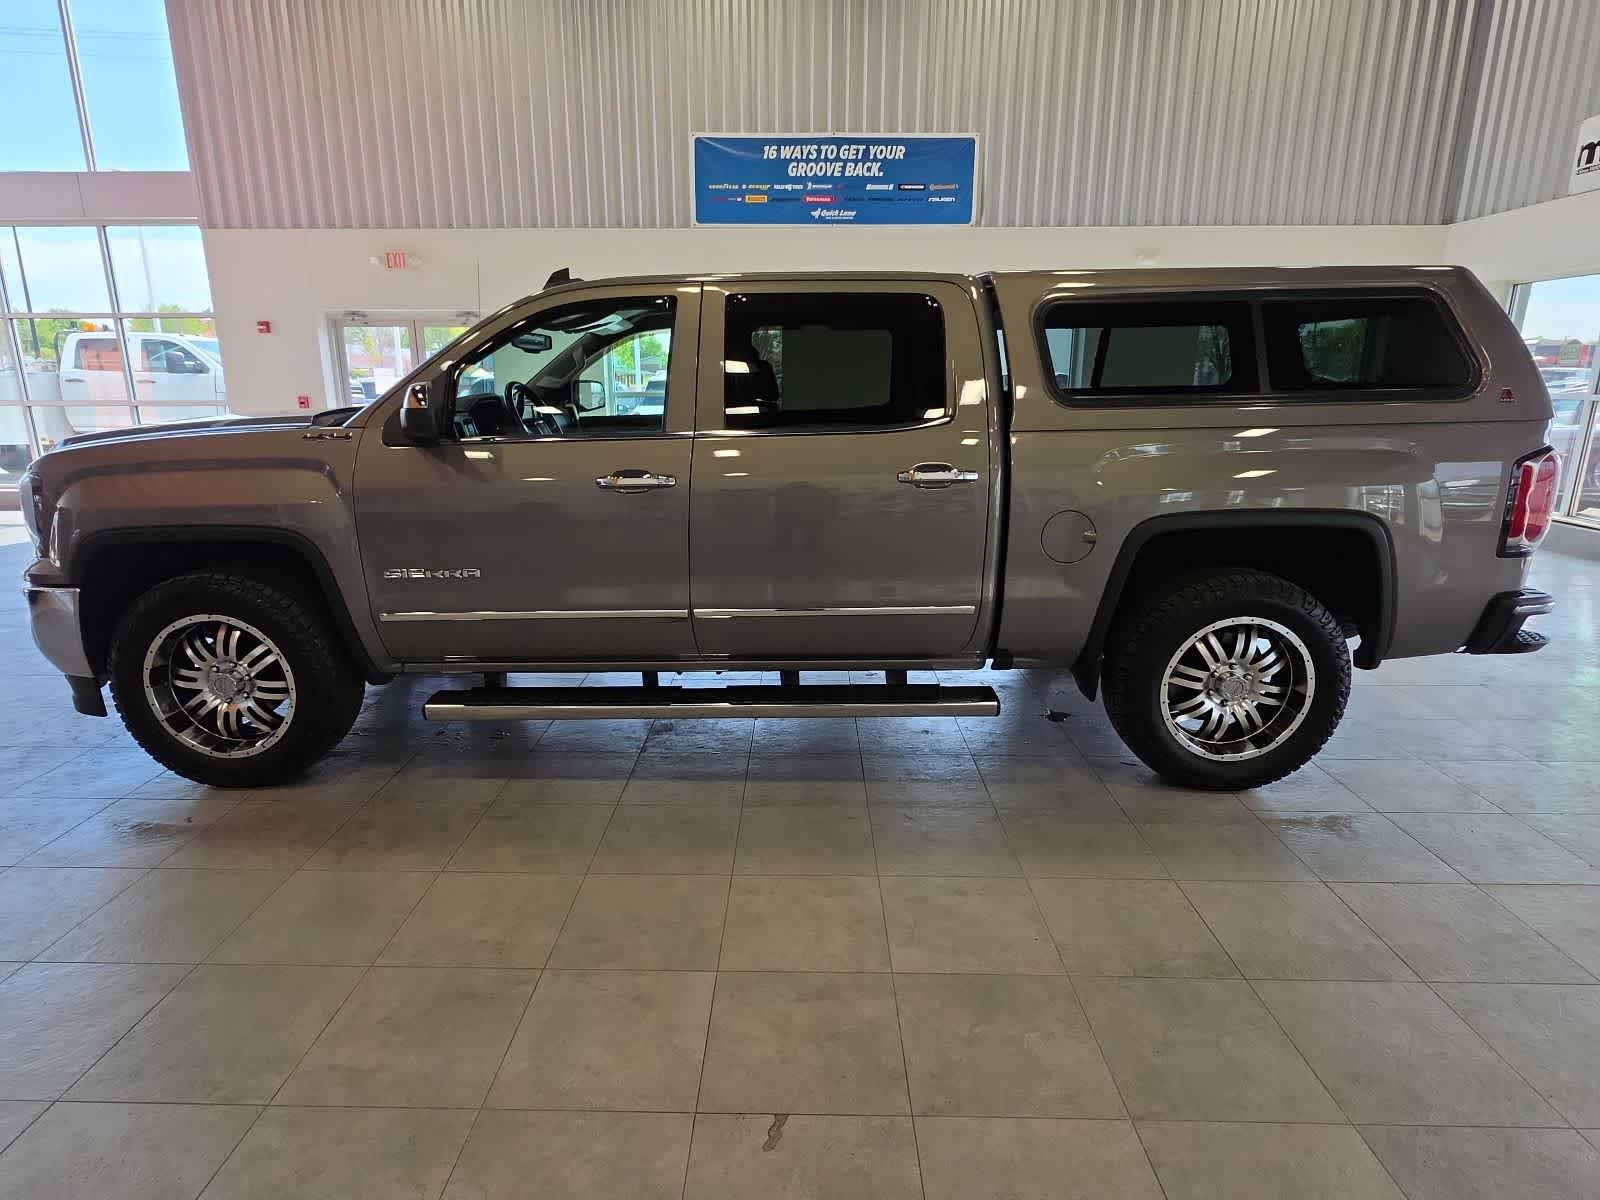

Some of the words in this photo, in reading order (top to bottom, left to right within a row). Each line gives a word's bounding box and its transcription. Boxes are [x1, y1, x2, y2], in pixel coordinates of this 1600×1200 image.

[763, 145, 778, 160] 16
[780, 145, 818, 160] WAYS
[820, 145, 837, 160] TO
[839, 145, 866, 160] GET
[868, 145, 906, 160] YOUR
[787, 162, 843, 177] GROOVE
[844, 162, 884, 177] BACK.
[385, 252, 406, 269] EXIT
[383, 568, 481, 579] SIERRA
